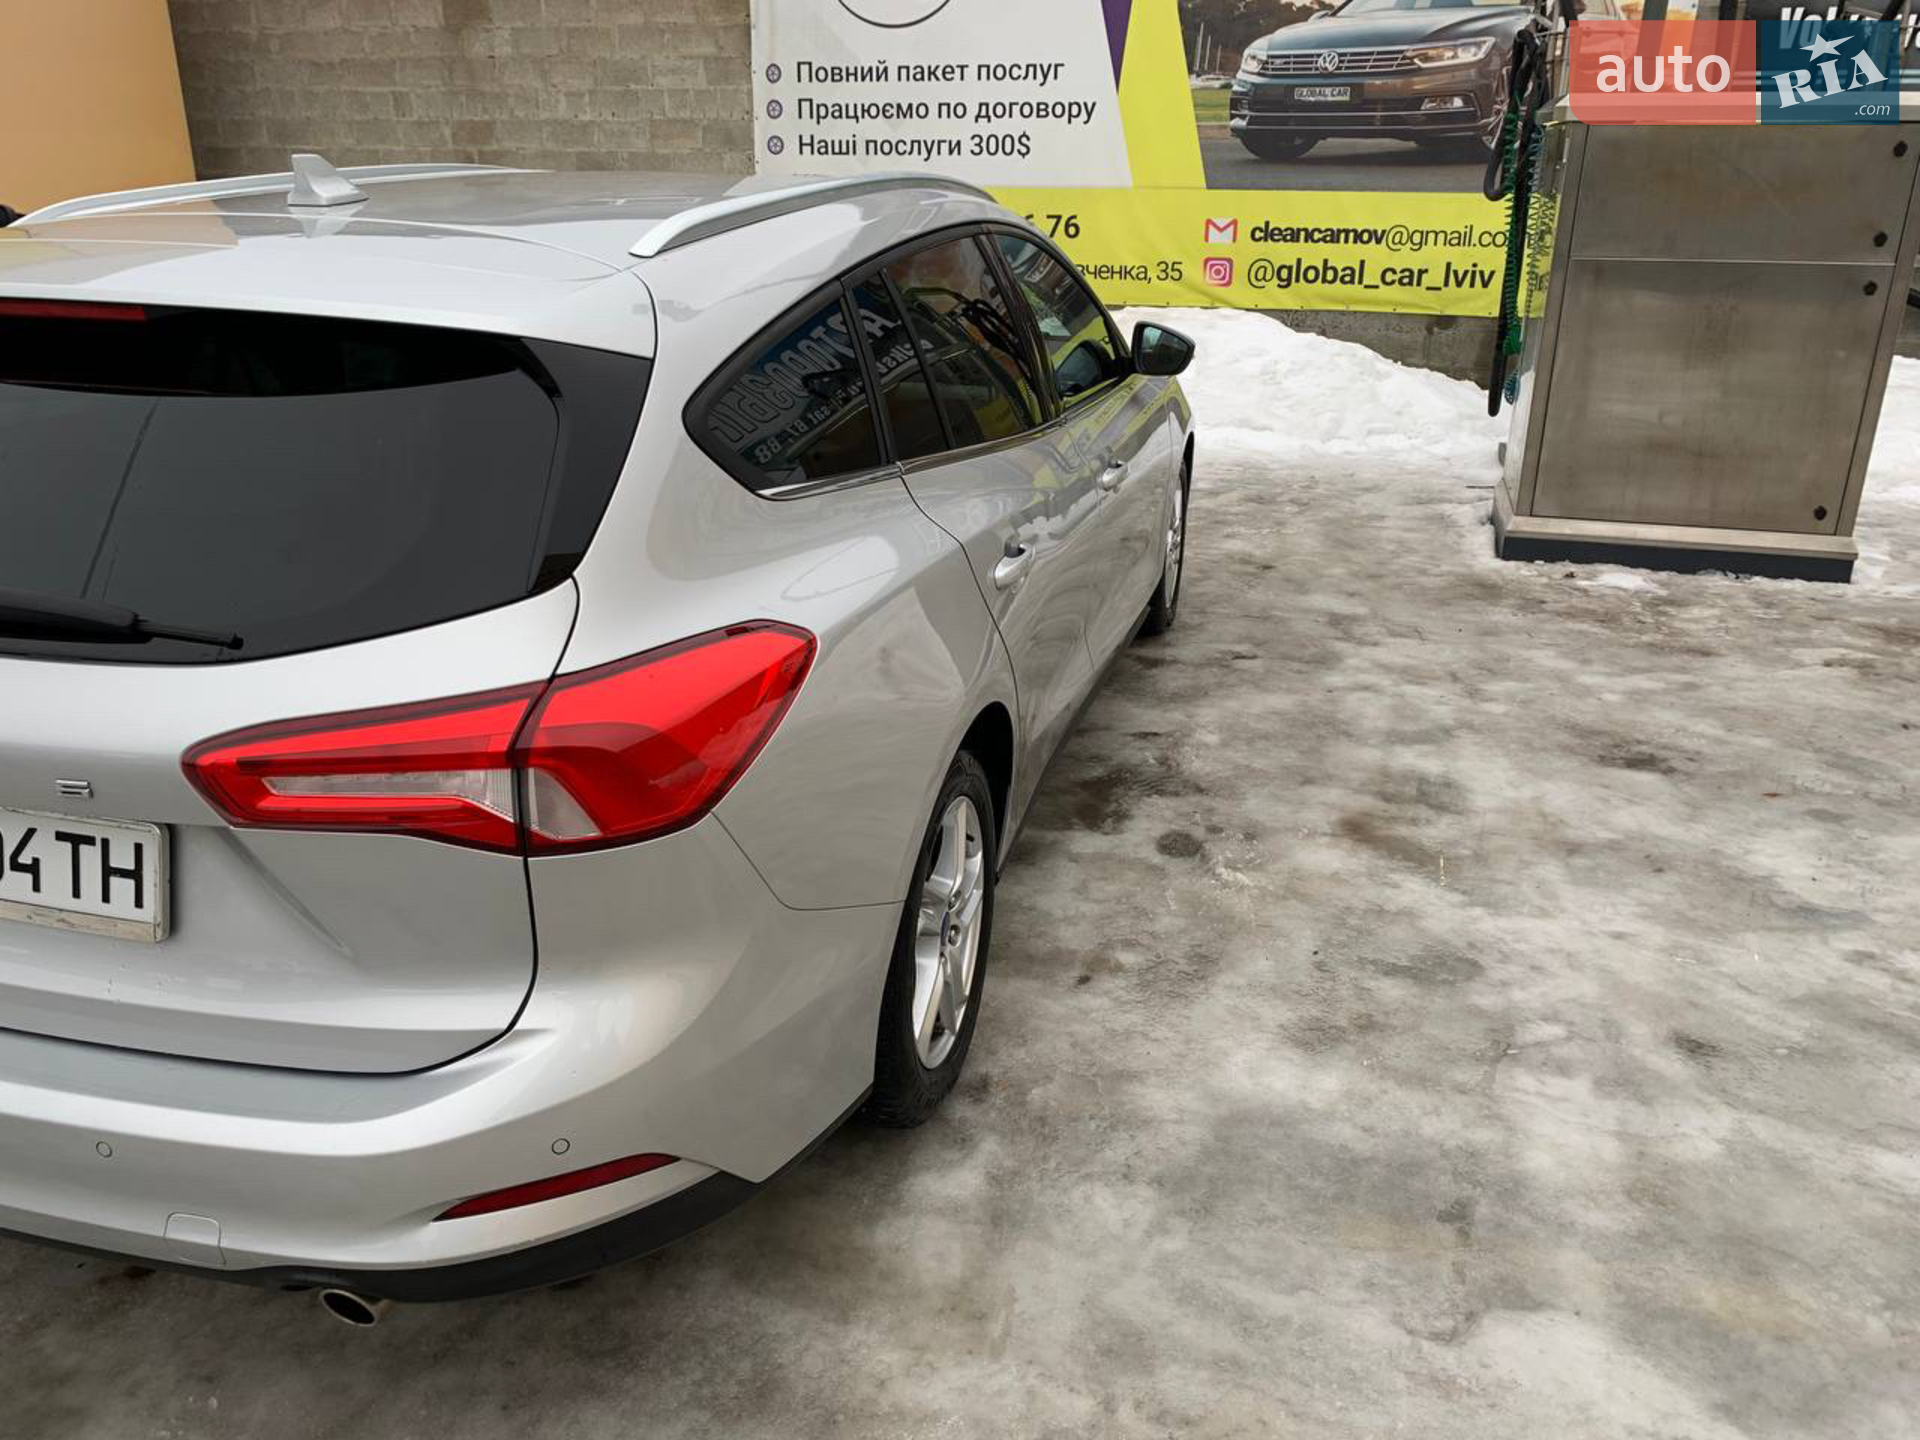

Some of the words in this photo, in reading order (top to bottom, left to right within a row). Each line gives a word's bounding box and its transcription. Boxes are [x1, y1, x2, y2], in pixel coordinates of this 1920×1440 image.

[796, 60, 889, 83] Повний
[897, 64, 969, 82] пакет
[977, 63, 1065, 87] послуг
[1296, 86, 1328, 98] GLOBAL
[1331, 86, 1349, 98] CAR
[797, 98, 930, 126] Працюємо
[937, 103, 967, 119] по
[974, 101, 1097, 125] договору
[798, 134, 857, 156] Наші
[865, 139, 961, 161] послуги
[970, 131, 1031, 159] 300$
[1046, 214, 1080, 239] 76
[1073, 263, 1151, 285] вченка,
[1156, 261, 1183, 282] 35
[1247, 257, 1496, 291] @global_car_lviv
